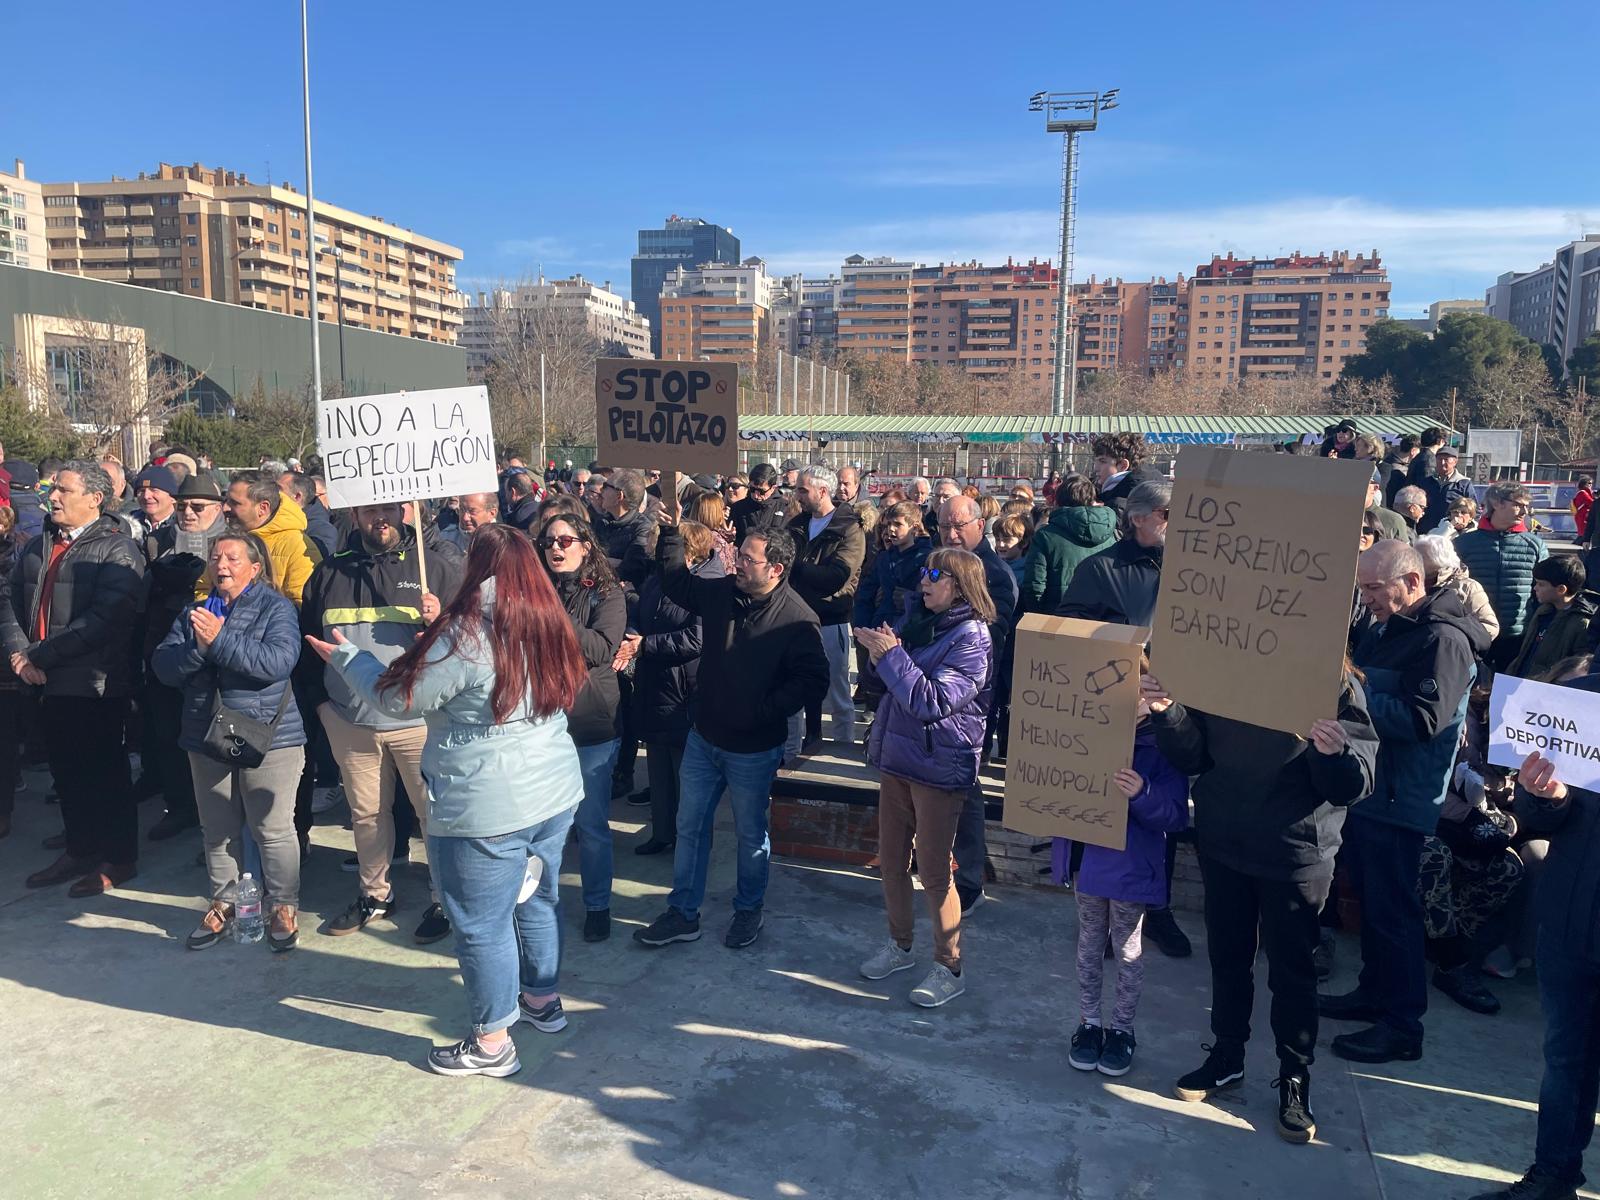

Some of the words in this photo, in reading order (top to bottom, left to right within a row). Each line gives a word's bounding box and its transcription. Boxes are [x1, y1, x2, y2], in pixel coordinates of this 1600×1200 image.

[615, 367, 711, 404] STOP
[397, 406, 416, 432] A
[433, 402, 465, 430] LA
[608, 402, 727, 447] PELOTAZO
[1184, 493, 1241, 527] LOS
[1177, 529, 1330, 582] TERRENOS
[1171, 568, 1226, 602] SON
[1256, 584, 1308, 618] DEL
[1170, 605, 1279, 656] BARRIO
[1030, 656, 1071, 685] MAS
[1022, 689, 1111, 725] OLLIES
[1525, 711, 1578, 734] ZONA
[1020, 718, 1089, 756] MENOS
[1505, 726, 1600, 763] DEPORTIVA
